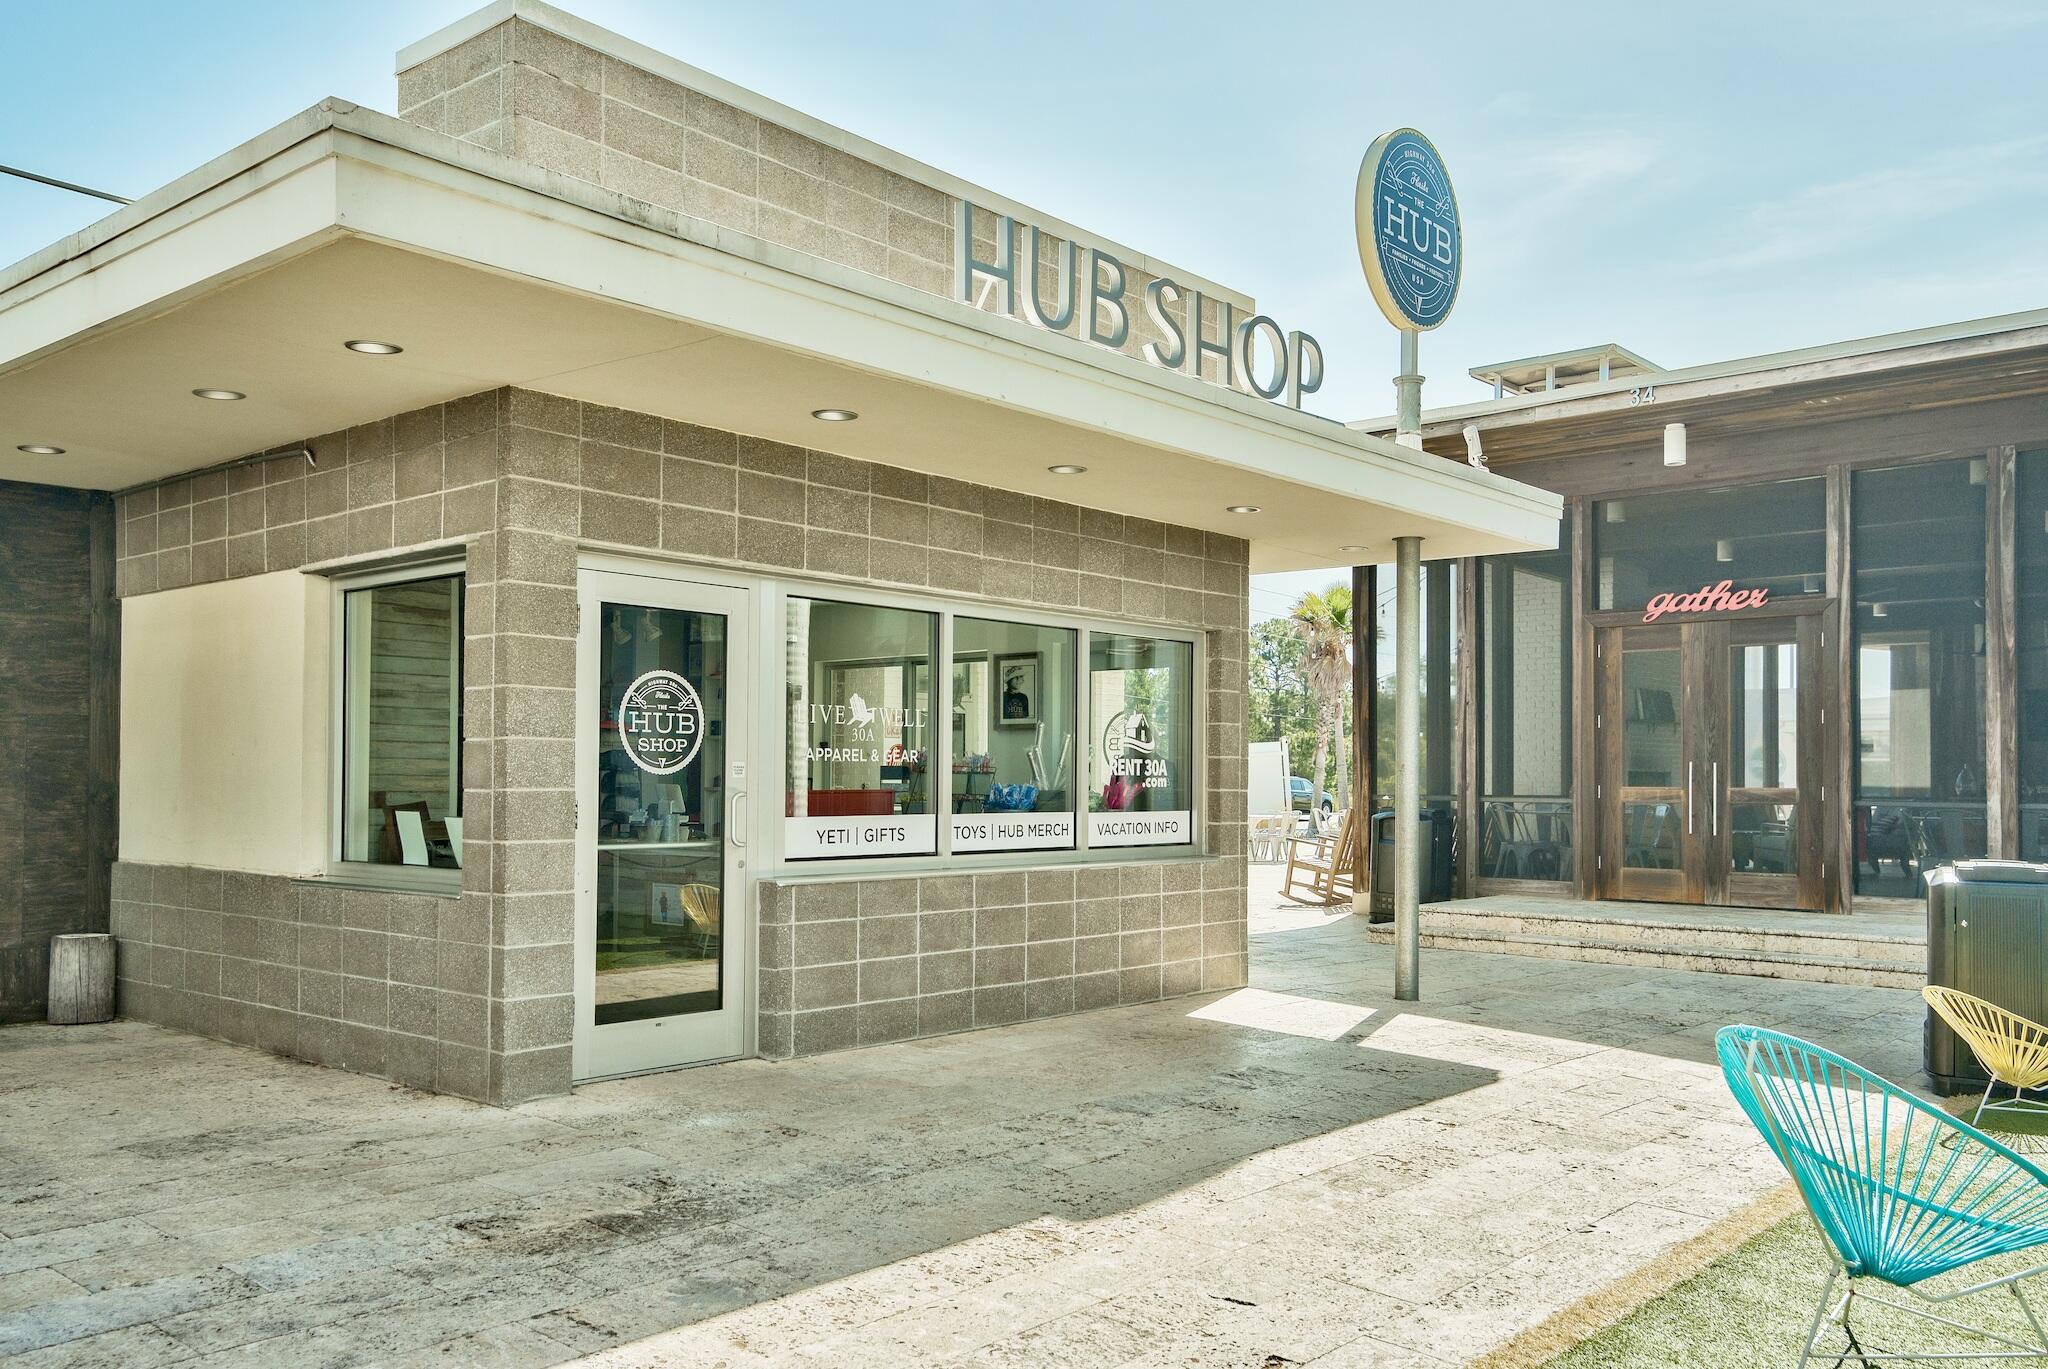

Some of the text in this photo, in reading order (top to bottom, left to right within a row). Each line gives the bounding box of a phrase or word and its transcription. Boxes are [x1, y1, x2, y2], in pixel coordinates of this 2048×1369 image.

[1414, 197, 1425, 210] THE
[1384, 196, 1452, 265] HUB
[1411, 274, 1424, 286] USA
[954, 200, 1324, 410] HUB SHOP
[1629, 386, 1656, 407] 34
[1642, 580, 1769, 623] gather
[628, 711, 696, 734] HUB
[878, 706, 925, 728] WELL
[851, 728, 874, 742] 30A
[638, 738, 688, 752] SHOP
[805, 747, 919, 763] APPAREL & GEAR
[1110, 758, 1168, 776] RENT 30A
[1142, 777, 1167, 788] .com
[816, 827, 905, 844] YETI GIFTS
[953, 823, 1069, 840] TOYS HUB MERCH
[1097, 821, 1179, 836] VACATION INFO
